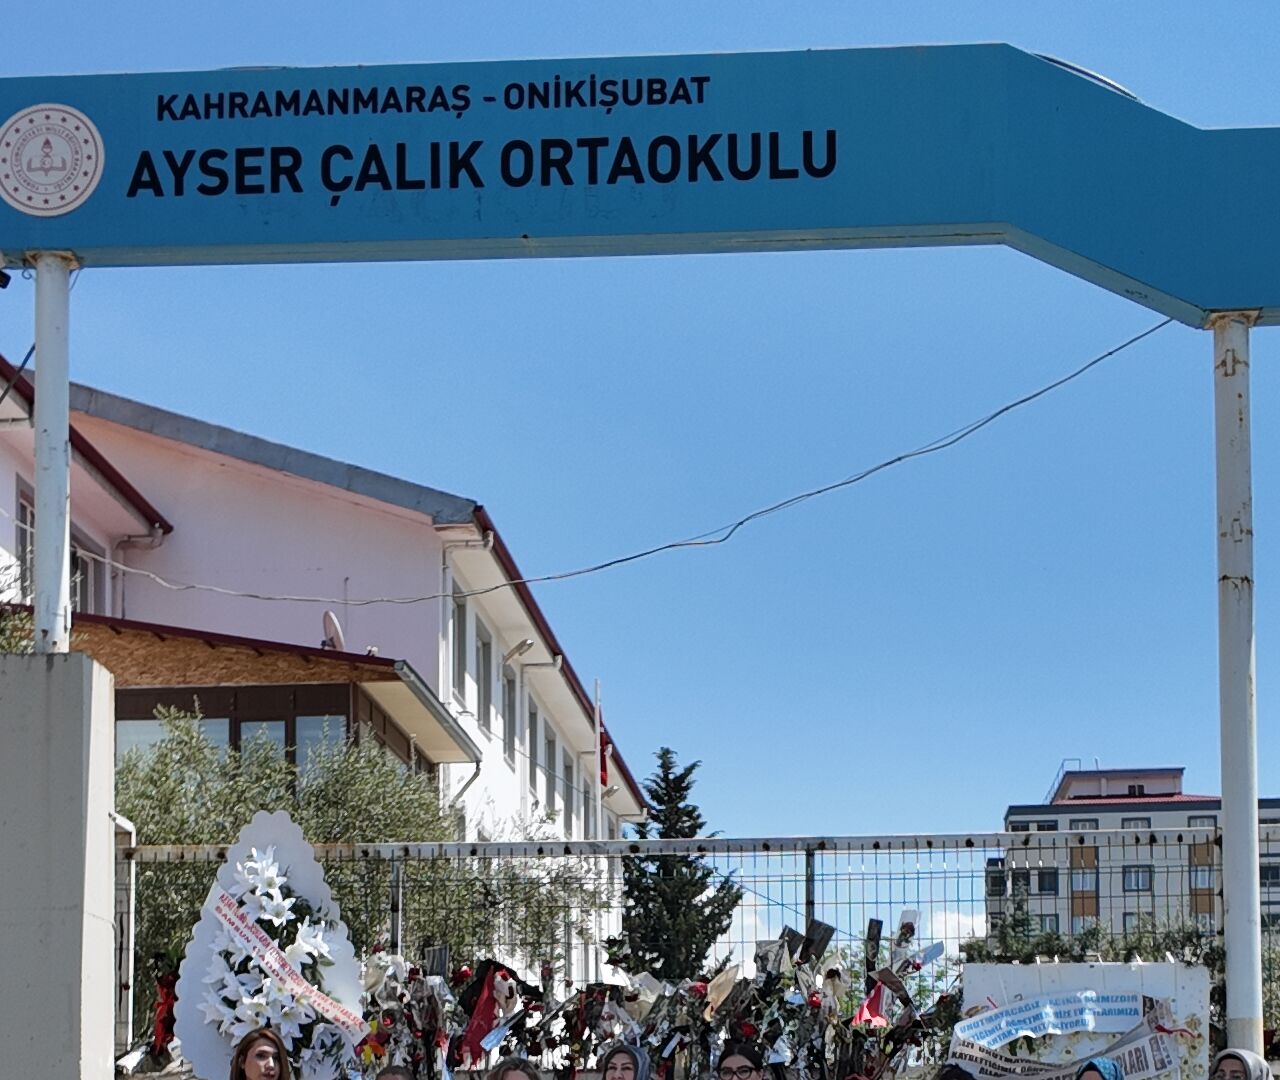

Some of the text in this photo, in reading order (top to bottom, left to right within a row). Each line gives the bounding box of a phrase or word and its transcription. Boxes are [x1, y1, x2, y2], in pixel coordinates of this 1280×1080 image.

[156, 85, 472, 121] KAHRAMANMARAŞ
[503, 74, 711, 115] ONİKİŞUBAT
[126, 146, 304, 198] AYSER
[320, 141, 485, 207] ÇALIK
[499, 129, 838, 188] ORTAOKULU
